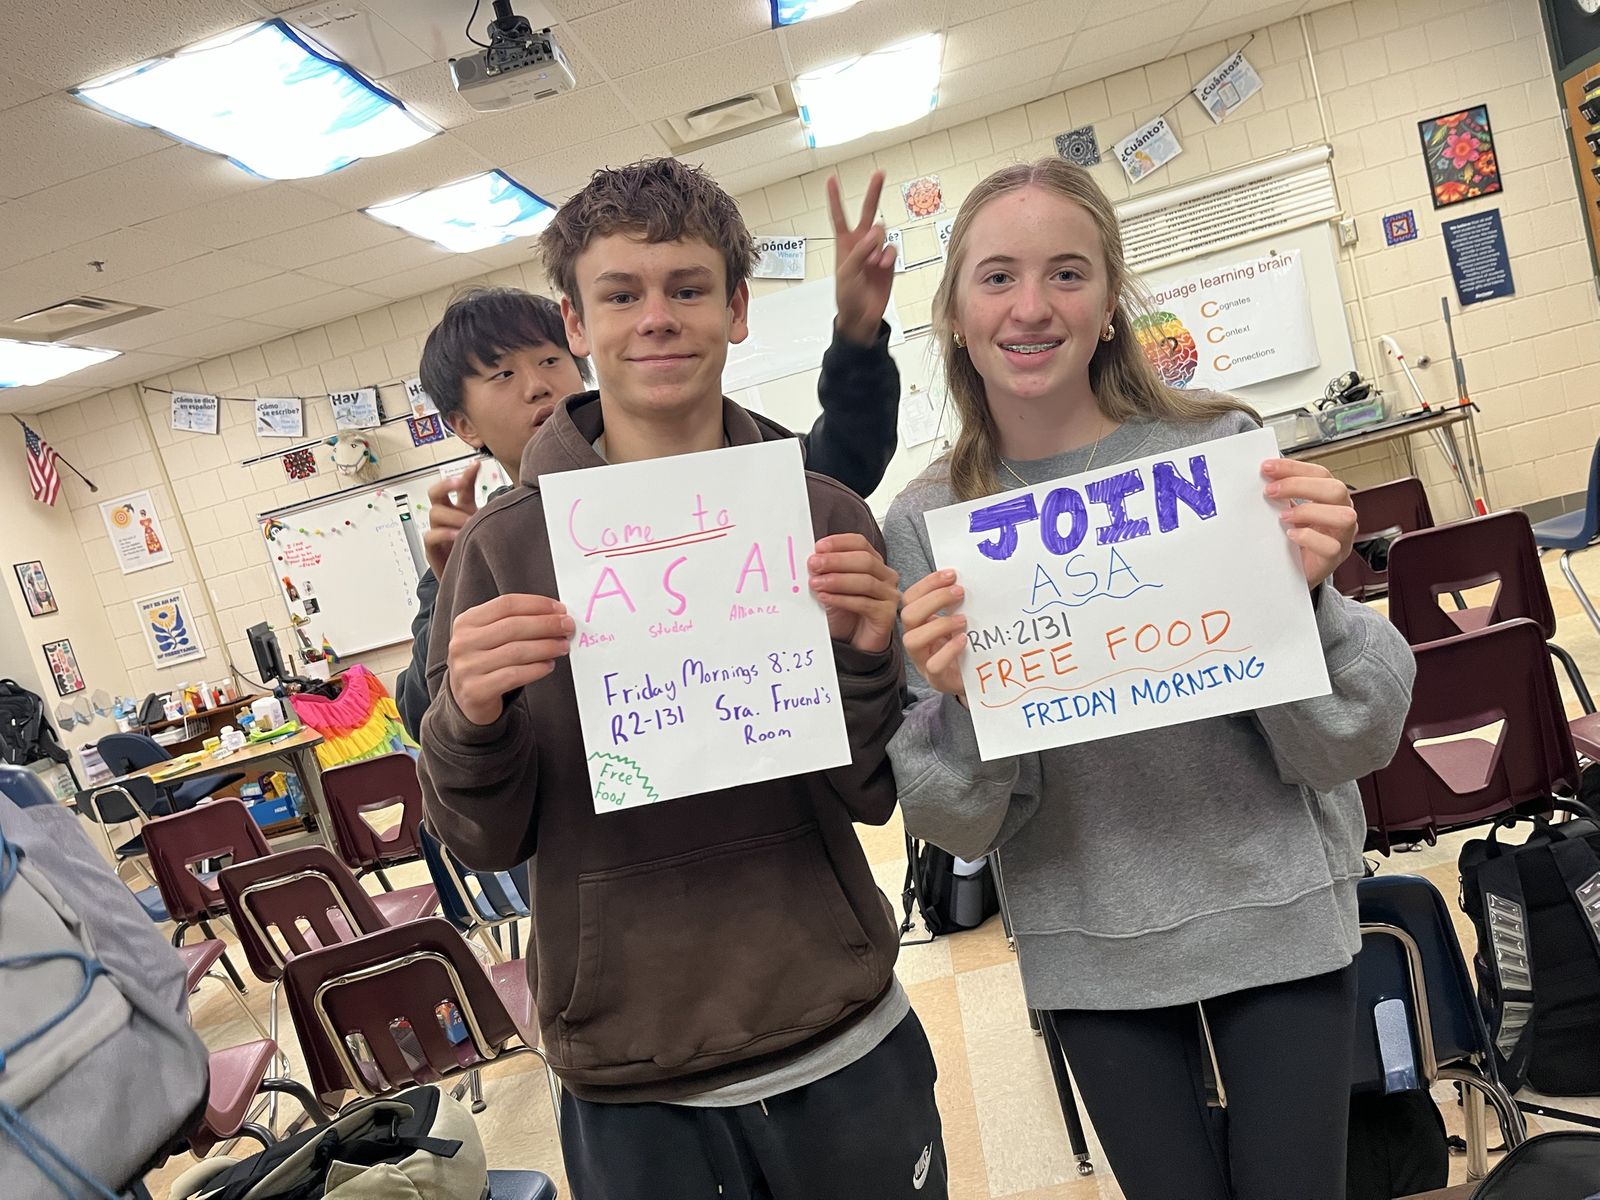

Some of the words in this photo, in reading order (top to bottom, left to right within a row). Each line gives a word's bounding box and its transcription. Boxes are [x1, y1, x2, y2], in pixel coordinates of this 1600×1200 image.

[1200, 55, 1243, 101] ¿Cuántos?
[1121, 120, 1165, 162] ¿Cuánto?
[1200, 264, 1254, 291] learning
[1257, 253, 1292, 274] brain
[1200, 295, 1251, 319] Cognates
[1206, 324, 1250, 344] Context
[1213, 346, 1276, 372] Connections
[332, 392, 359, 406] Hay
[569, 498, 653, 552] Come
[691, 494, 730, 531] to
[969, 455, 1216, 561] JOIN
[1031, 547, 1139, 605] ASA
[579, 631, 615, 647] Asian
[650, 620, 694, 638] Student
[730, 604, 780, 621] Alliance
[968, 611, 1072, 652] RM:2131
[975, 642, 1078, 694] FREE
[1106, 610, 1231, 661] FOOD
[604, 672, 677, 707] Friday
[683, 658, 759, 688] Mornings
[768, 650, 814, 673] 8:25
[1022, 687, 1116, 727] FRIDAY
[1132, 656, 1265, 705] MORNING
[612, 707, 684, 745] R2-131
[716, 695, 759, 721] Sra.
[771, 684, 831, 713] Fruend's
[744, 725, 791, 745] Room
[595, 782, 626, 806] Food
[600, 763, 633, 786] Free
